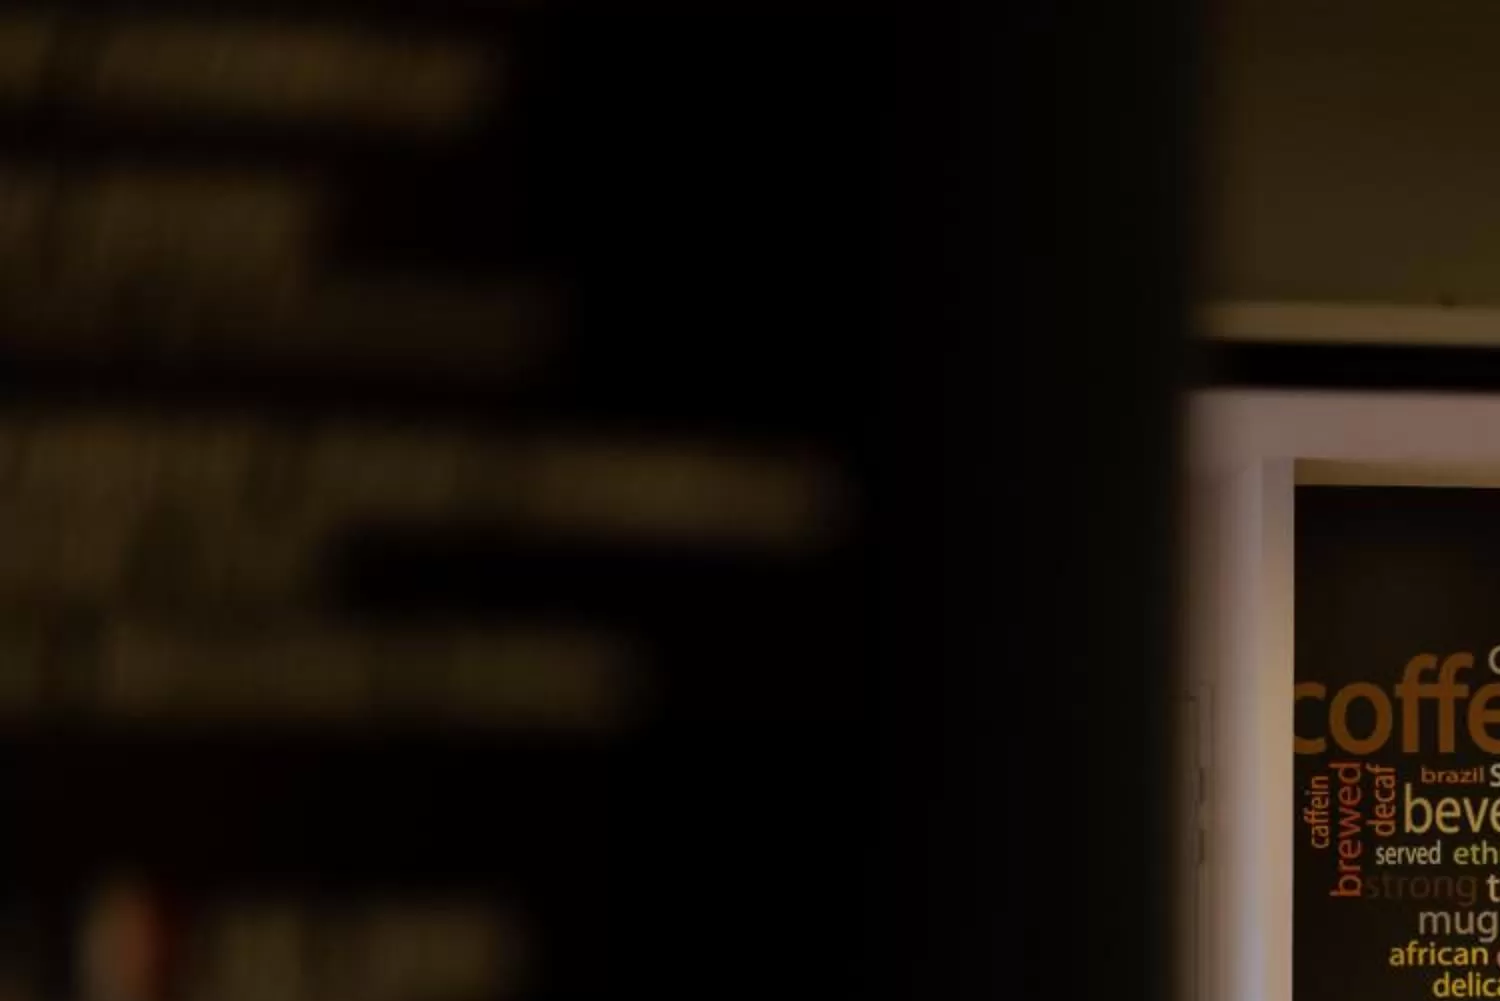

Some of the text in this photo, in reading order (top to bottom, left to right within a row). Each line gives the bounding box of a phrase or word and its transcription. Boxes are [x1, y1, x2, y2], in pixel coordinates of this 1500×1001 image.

[1420, 766, 1485, 785] brazil
[1303, 775, 1329, 849] caffein
[1366, 763, 1396, 837] decaf
[1328, 760, 1362, 897] brewed
[1375, 839, 1442, 866] served
[1365, 870, 1477, 908] strong
[1418, 910, 1499, 943] mug
[1388, 939, 1489, 967] african
